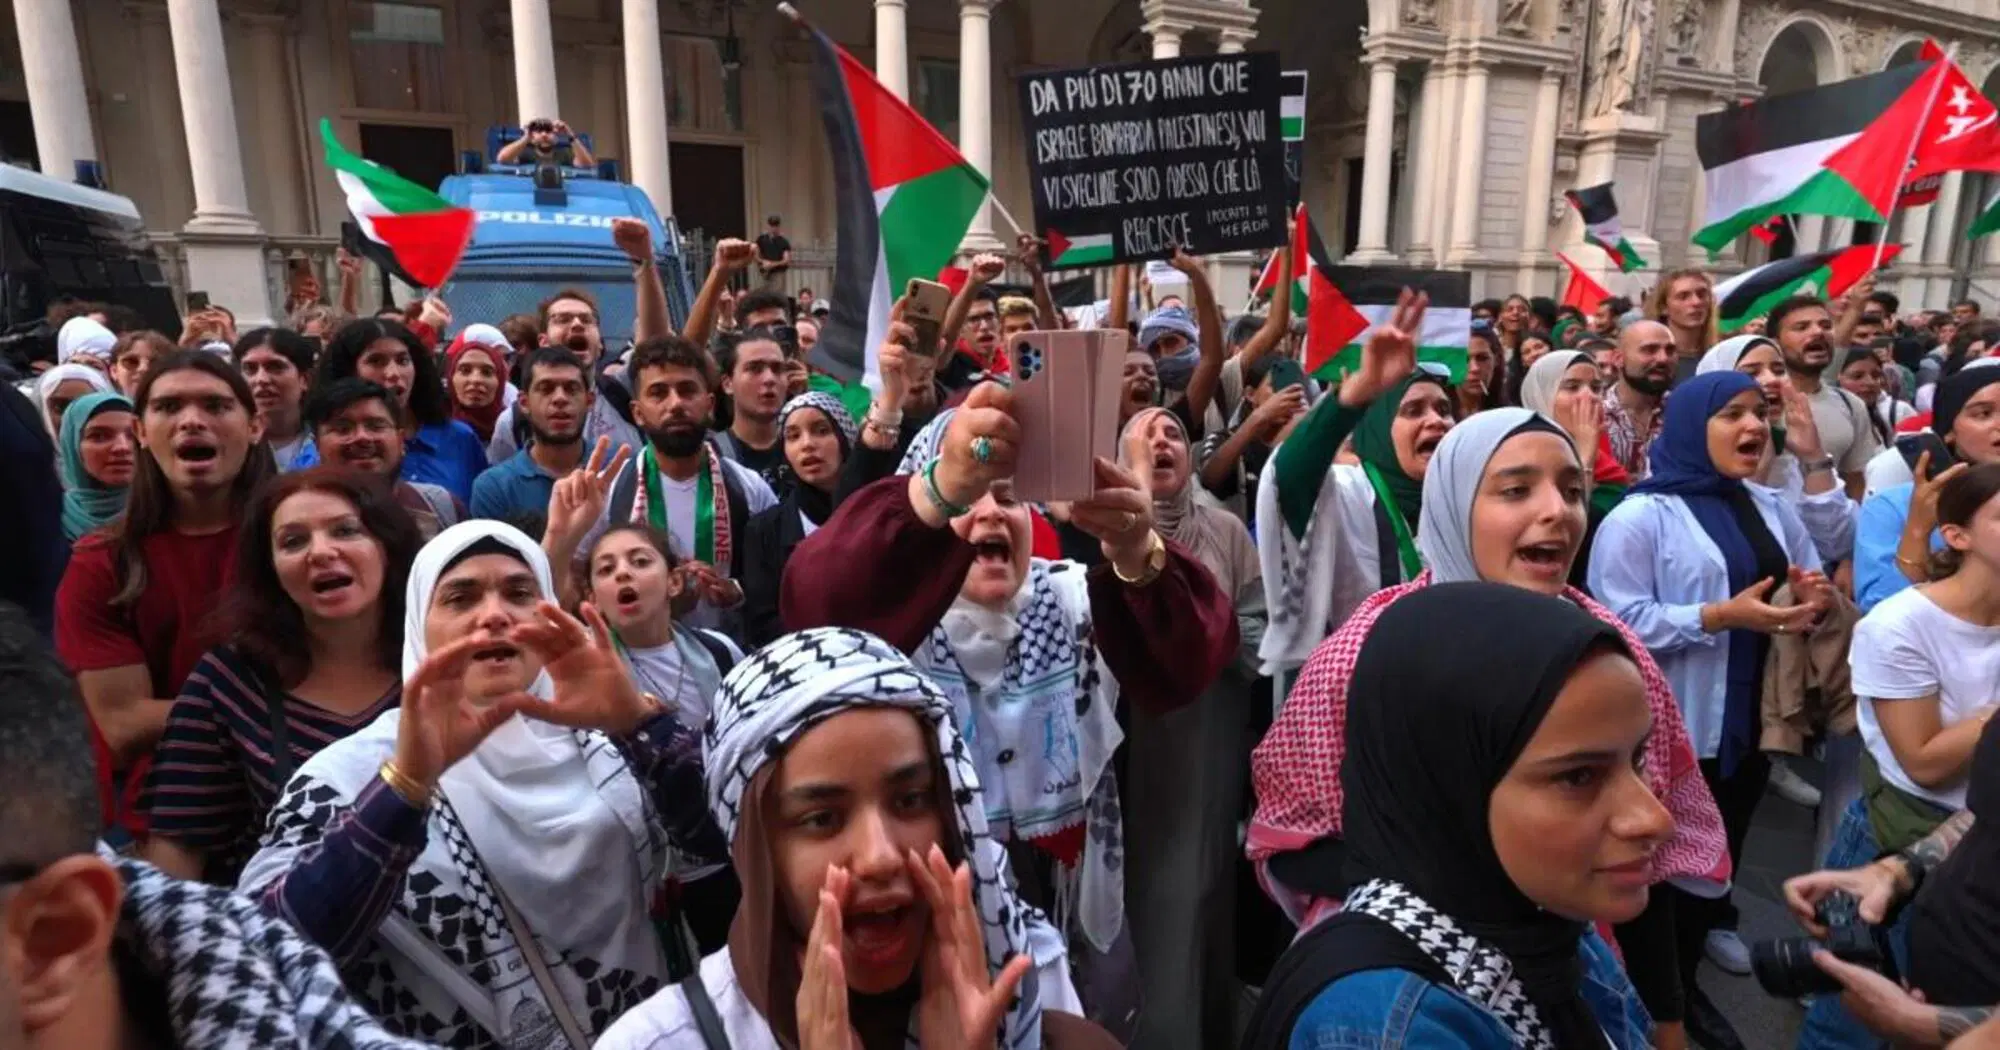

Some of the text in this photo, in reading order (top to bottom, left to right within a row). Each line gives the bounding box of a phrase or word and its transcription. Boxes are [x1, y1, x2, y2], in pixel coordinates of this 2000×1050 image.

[1029, 79, 1060, 117] DA
[1101, 72, 1123, 107] DI
[1124, 70, 1157, 105] 70
[1161, 65, 1204, 100] ANNI
[1209, 61, 1249, 96] CHE
[1036, 124, 1089, 165] ISRAELE
[1089, 119, 1156, 157] BOMBARDA
[1238, 109, 1266, 142] VOI
[1042, 176, 1060, 210] VI
[1122, 165, 1160, 203] SOLO
[1166, 161, 1209, 199] ADESSO
[1213, 158, 1241, 195] CHE
[1220, 219, 1269, 237] MERDA
